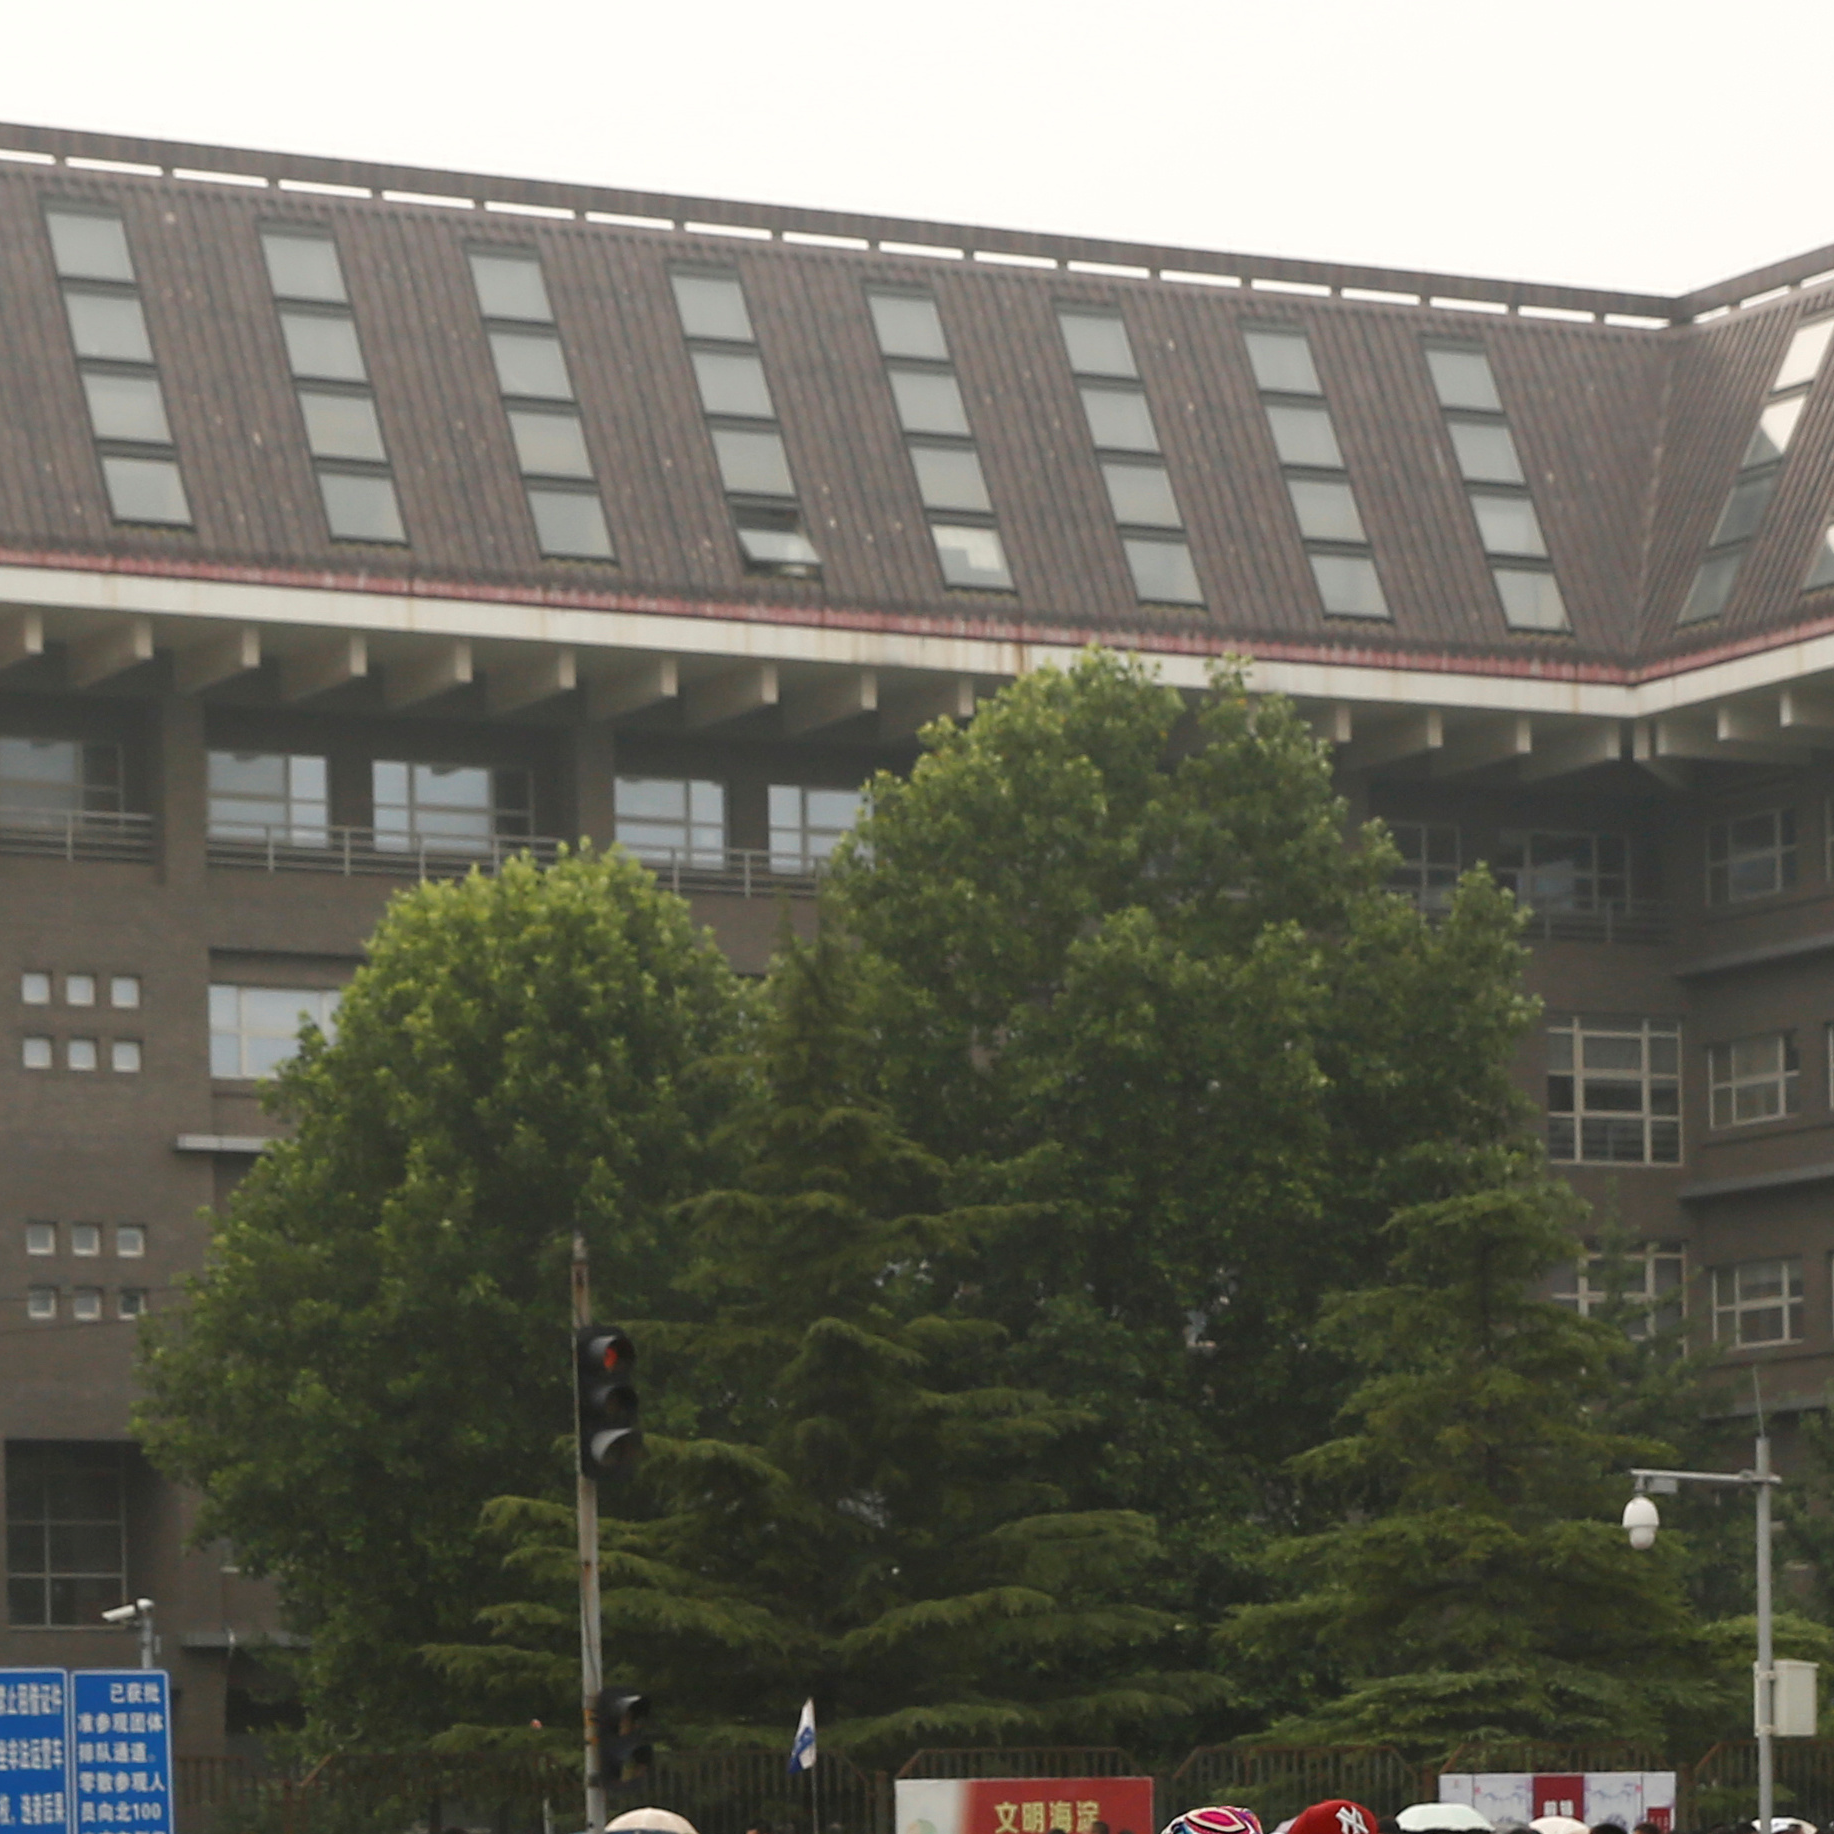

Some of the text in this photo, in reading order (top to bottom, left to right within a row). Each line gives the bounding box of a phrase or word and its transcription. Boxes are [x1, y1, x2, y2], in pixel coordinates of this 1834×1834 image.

[109, 1682, 161, 1704] 已获批
[77, 1712, 164, 1733] 准参观团体
[79, 1771, 166, 1793] 零散参观人
[81, 1801, 162, 1822] 员向北100
[994, 1800, 1100, 1834] 文明海淀
